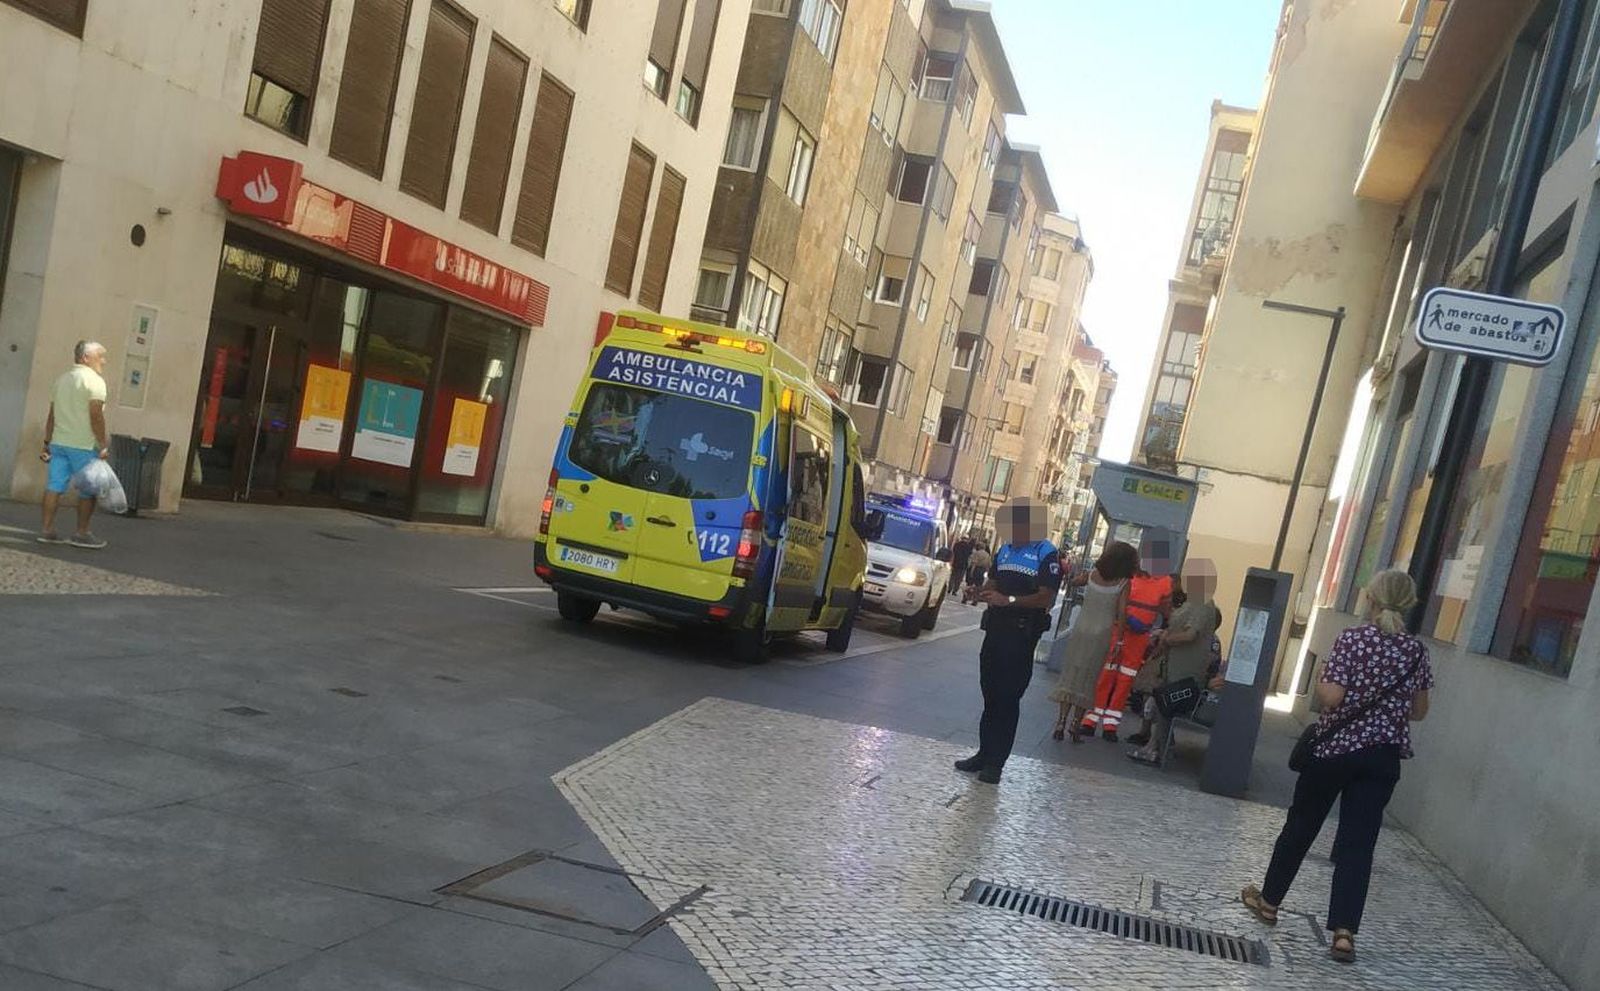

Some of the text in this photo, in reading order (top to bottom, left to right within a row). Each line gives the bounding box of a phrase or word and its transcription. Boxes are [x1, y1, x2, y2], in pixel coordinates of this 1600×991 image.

[1447, 308, 1509, 325] mercado
[1444, 321, 1528, 343] de abastos
[612, 350, 745, 388] AMBULANCIA
[608, 366, 742, 404] ASISTENCIAL
[1142, 484, 1184, 500] ONCE
[699, 530, 731, 555] 112
[567, 552, 617, 570] 2080 HRY
